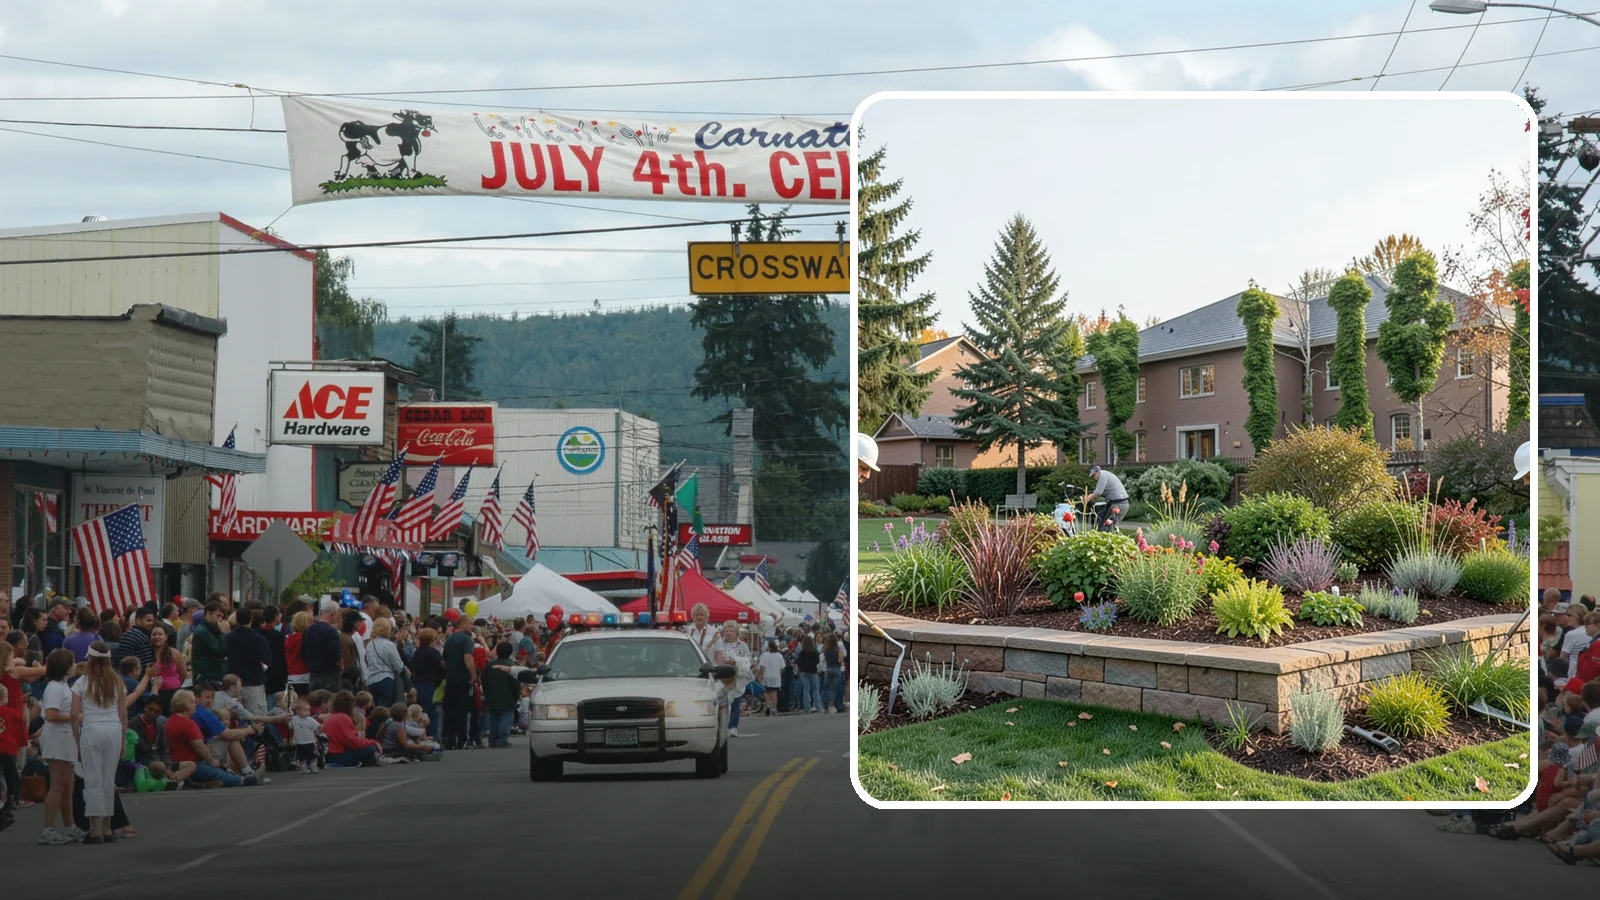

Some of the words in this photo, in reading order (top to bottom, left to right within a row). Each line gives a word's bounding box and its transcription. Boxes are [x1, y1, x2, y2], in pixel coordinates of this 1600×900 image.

[481, 141, 605, 192] JULY
[632, 150, 747, 198] 4th.
[697, 254, 850, 280] CROSSWA
[283, 380, 374, 420] ACE
[406, 409, 452, 422] CEDAR
[283, 421, 371, 437] Hardware
[416, 428, 477, 447] Coca-Cola
[354, 467, 384, 481] Simpl
[83, 484, 93, 494] St.
[96, 485, 124, 495] Vincent
[126, 486, 136, 495] de
[137, 485, 155, 495] Paul
[688, 526, 741, 535] CRNATION
[699, 535, 730, 543] GLASS
